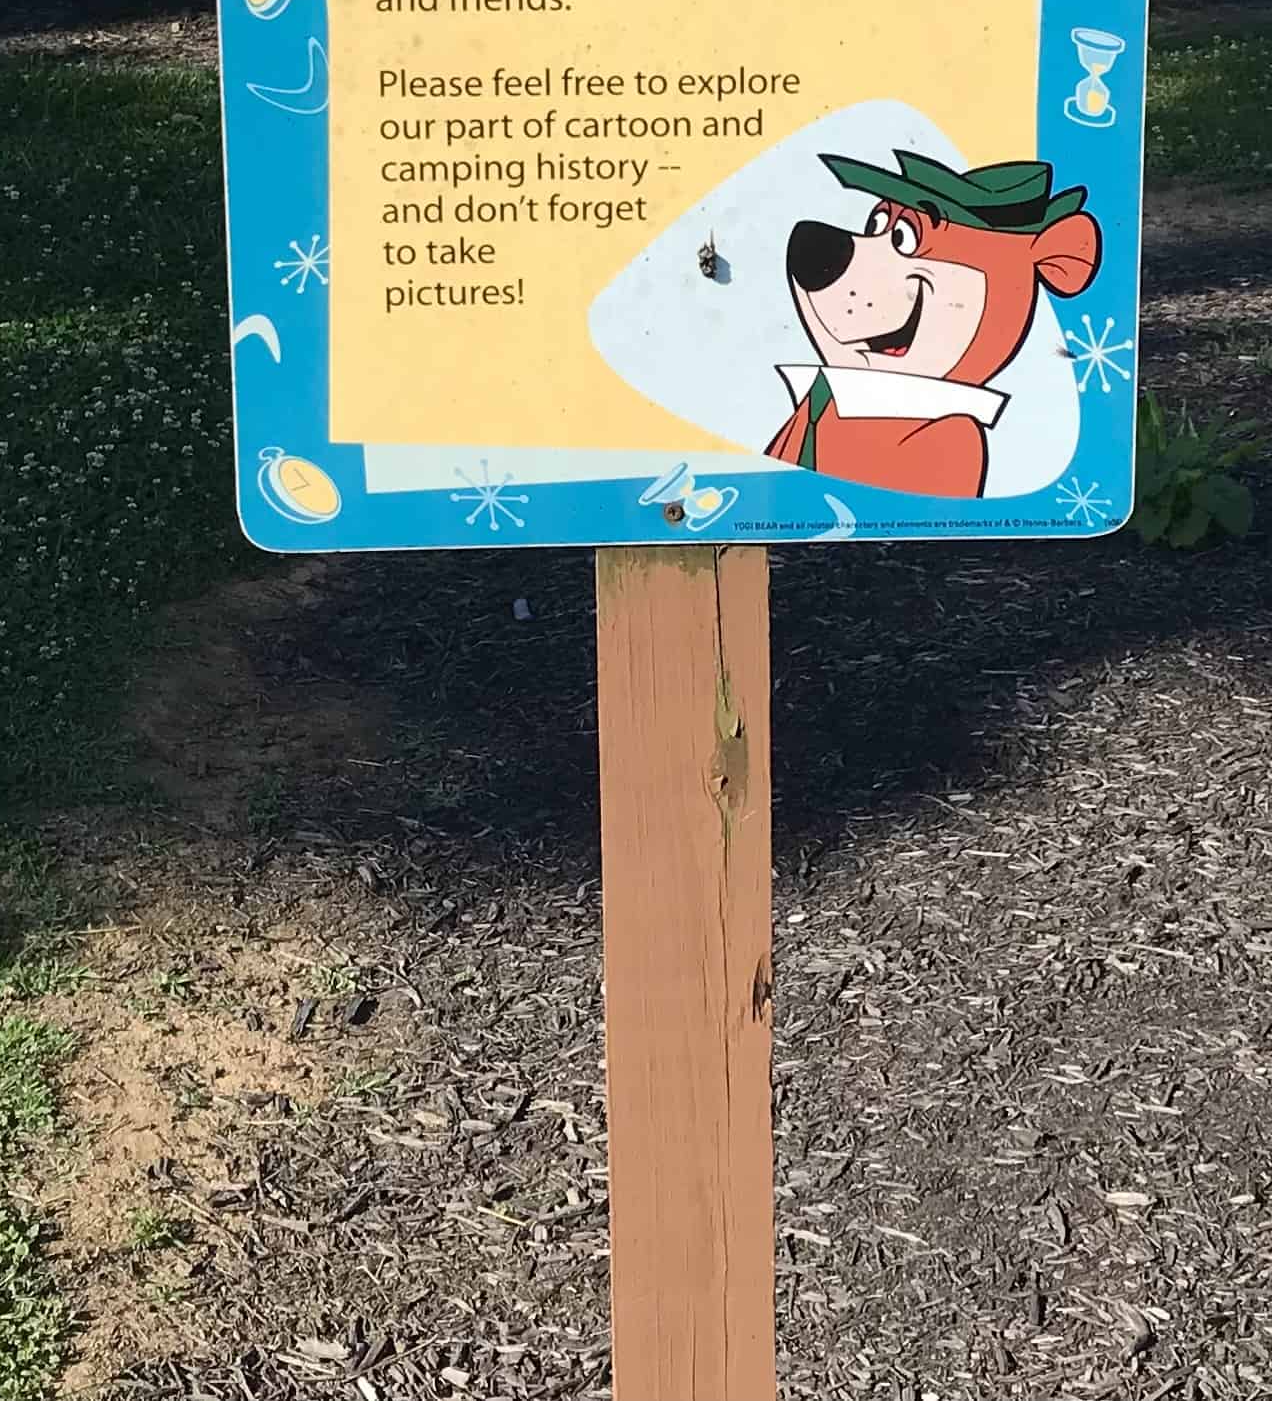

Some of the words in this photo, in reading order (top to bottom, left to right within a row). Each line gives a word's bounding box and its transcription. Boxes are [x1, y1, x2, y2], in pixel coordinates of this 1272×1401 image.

[379, 68, 484, 98] Please
[491, 67, 551, 98] feel
[560, 66, 625, 96] free
[633, 71, 668, 96] to
[677, 65, 801, 103] explore
[379, 118, 437, 141] our
[444, 114, 513, 147] part
[522, 108, 558, 139] of
[564, 113, 692, 139] cartoon
[702, 107, 763, 138] and
[381, 153, 525, 189] camping
[536, 151, 649, 188] history
[381, 194, 444, 224] and
[547, 192, 648, 229] forget
[382, 241, 417, 266] to
[425, 235, 496, 265] take
[385, 278, 524, 314] pictures!
[780, 522, 794, 530] and
[881, 520, 894, 529] and
[897, 520, 932, 529] elements
